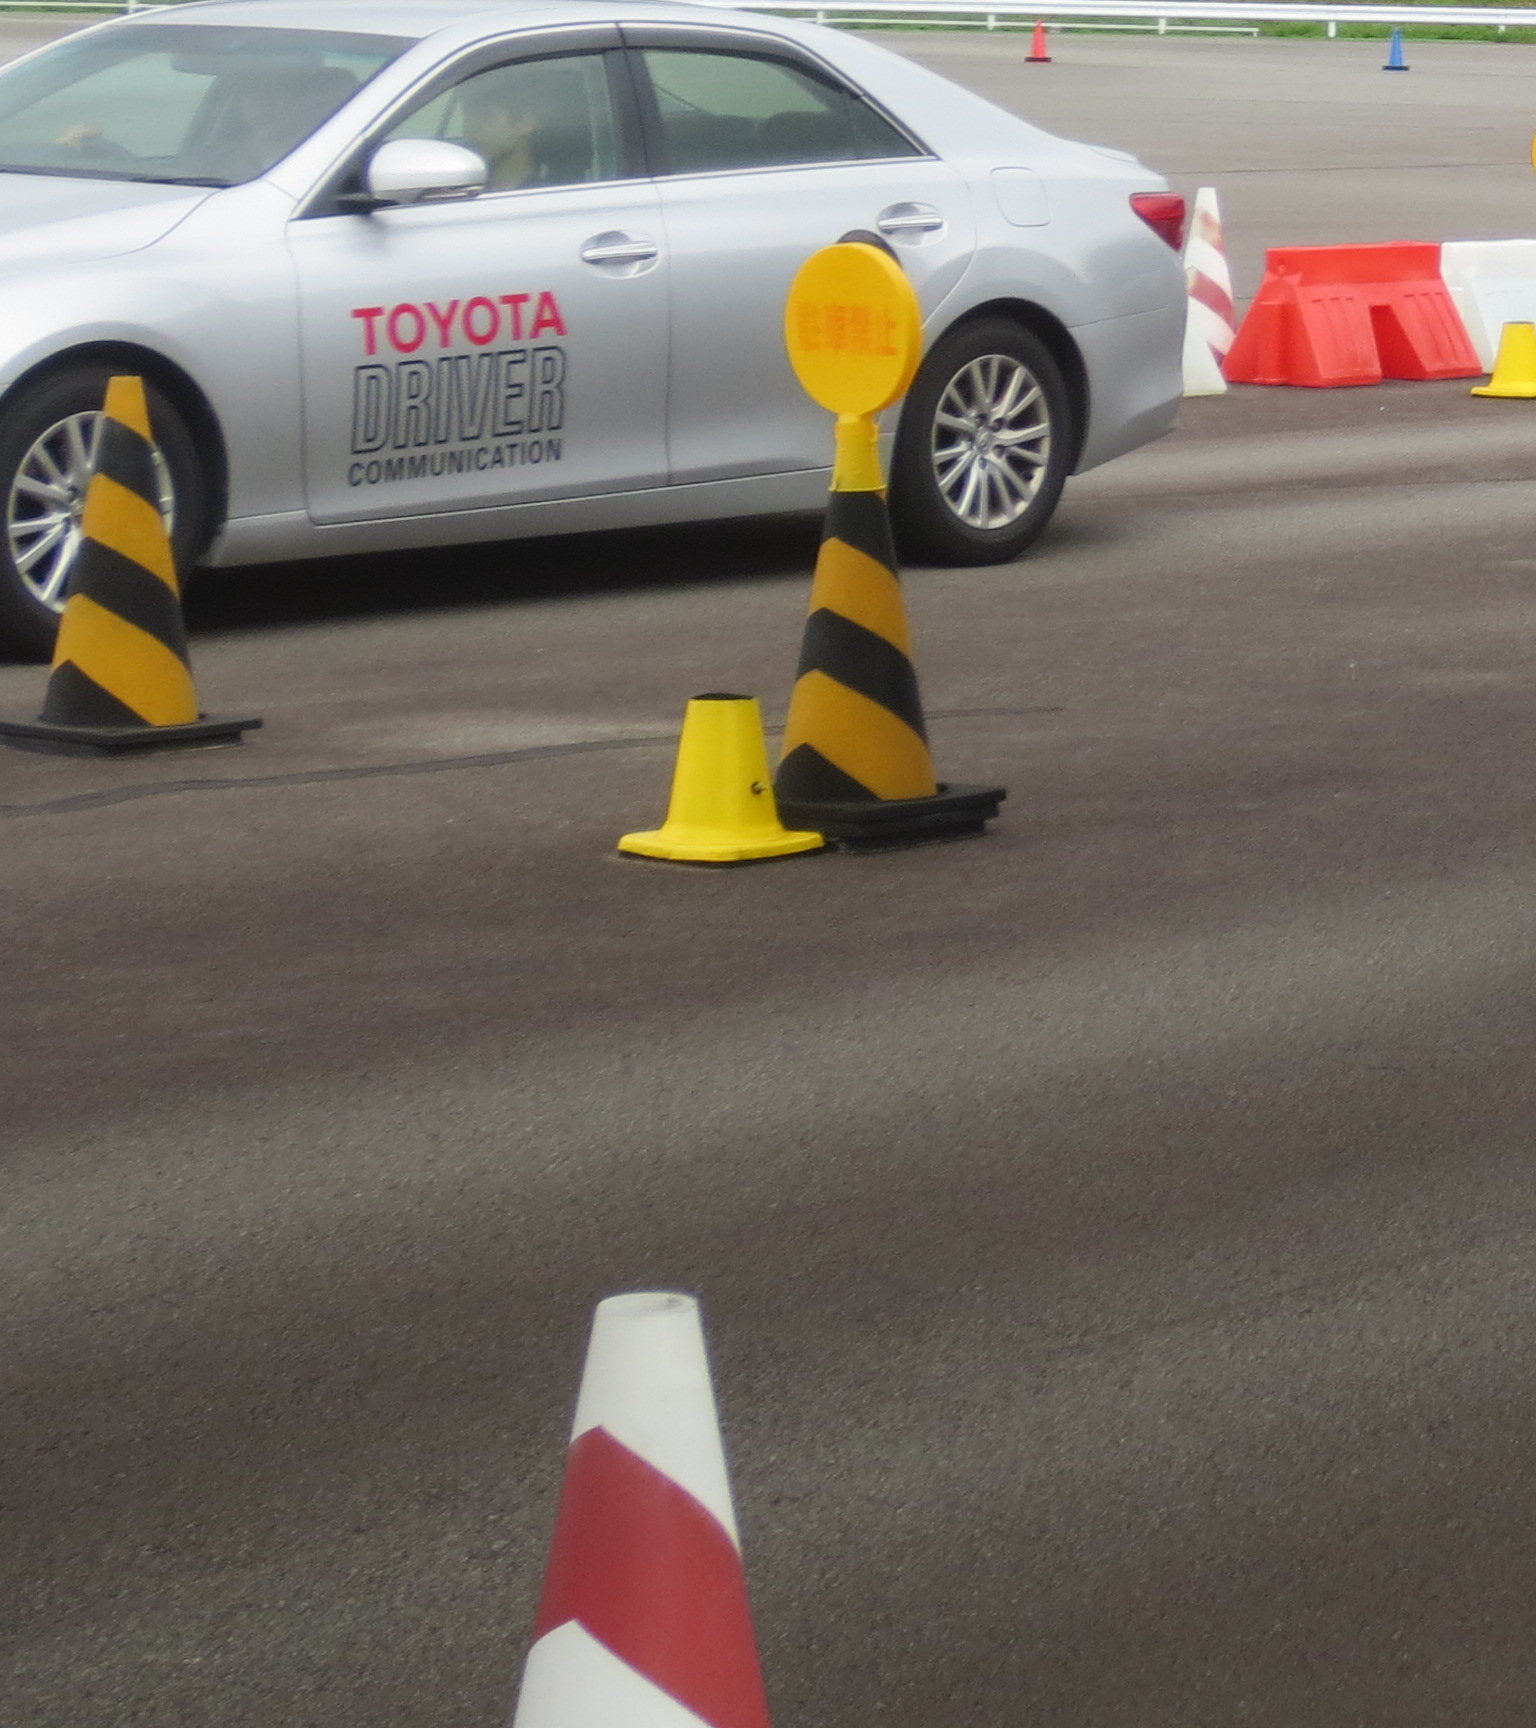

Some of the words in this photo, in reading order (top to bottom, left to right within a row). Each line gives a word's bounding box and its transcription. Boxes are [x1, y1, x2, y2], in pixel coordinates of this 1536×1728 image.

[351, 290, 568, 356] TOYOTA
[351, 345, 567, 455] DRIVER
[347, 438, 563, 487] COMMUNICATION
